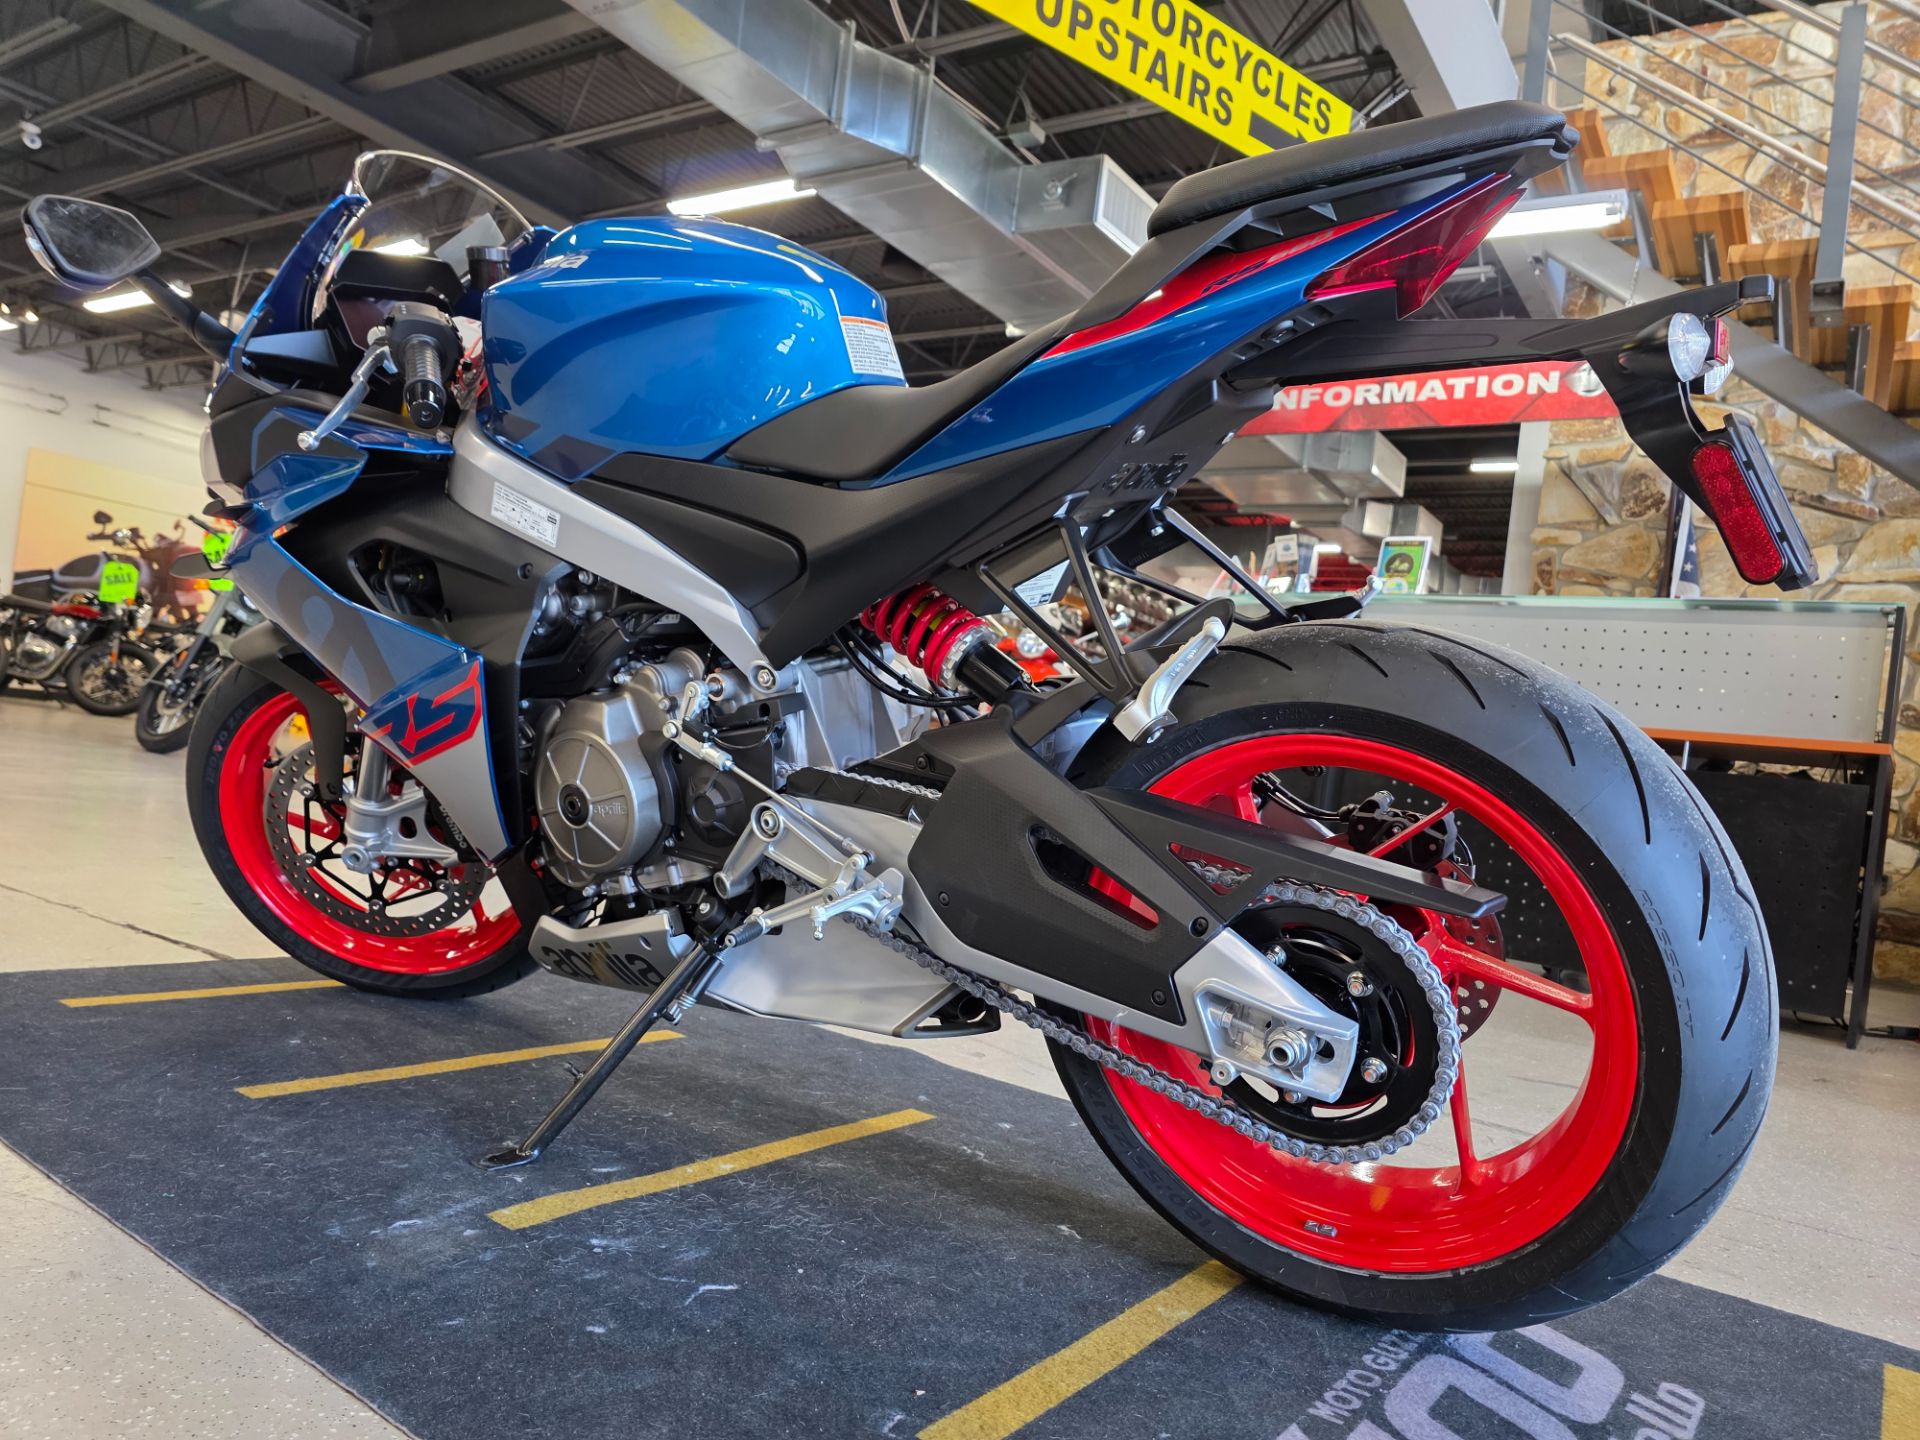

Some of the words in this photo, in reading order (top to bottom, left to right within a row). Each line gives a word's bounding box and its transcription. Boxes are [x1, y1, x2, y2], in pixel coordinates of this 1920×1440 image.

[1036, 0, 1234, 126] UPSTAIRS
[1100, 0, 1331, 134] ORCYCLES
[1272, 370, 1560, 411] NFORMATION
[540, 941, 667, 988] aprilia
[1306, 1369, 1383, 1436] MOTO
